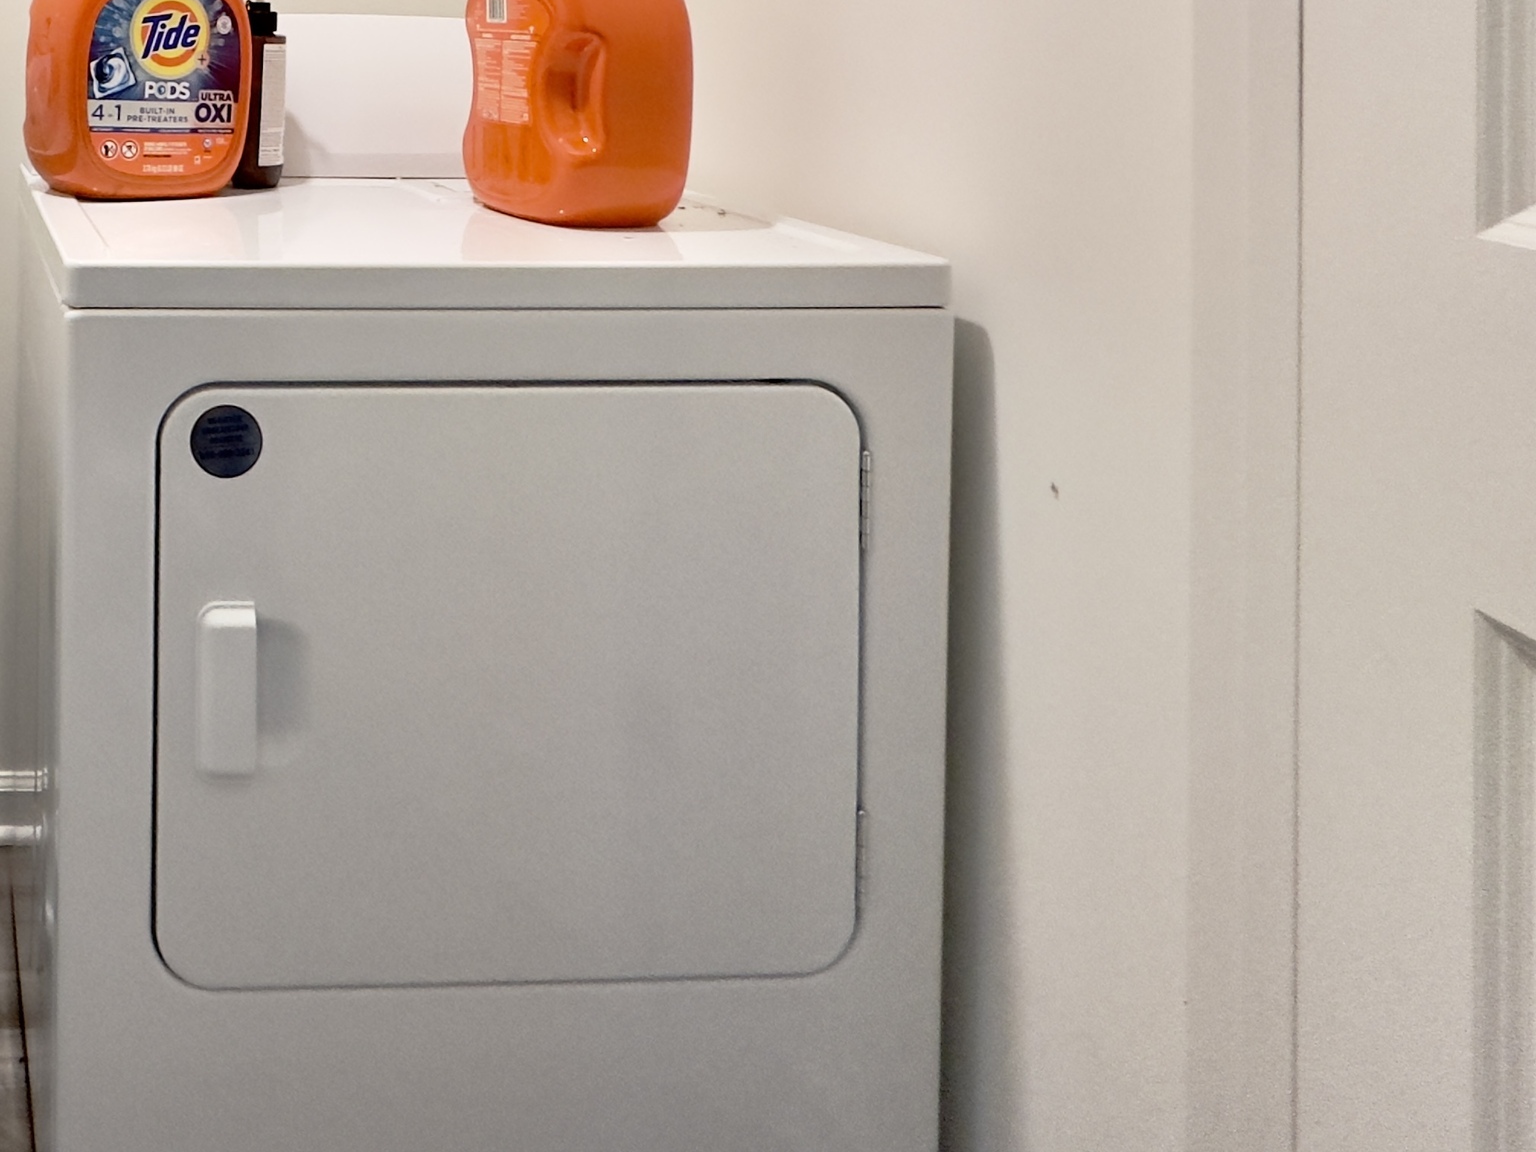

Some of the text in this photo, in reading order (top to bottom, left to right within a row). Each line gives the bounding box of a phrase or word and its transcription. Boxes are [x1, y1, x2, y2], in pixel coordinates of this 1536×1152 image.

[141, 12, 201, 60] Tide
[144, 81, 191, 100] PODS
[200, 92, 232, 102] ULTRA
[91, 104, 105, 121] 4
[127, 115, 188, 123] PRE-TREATERS
[139, 107, 175, 115] BUILT-IN
[194, 103, 232, 123] OXI
